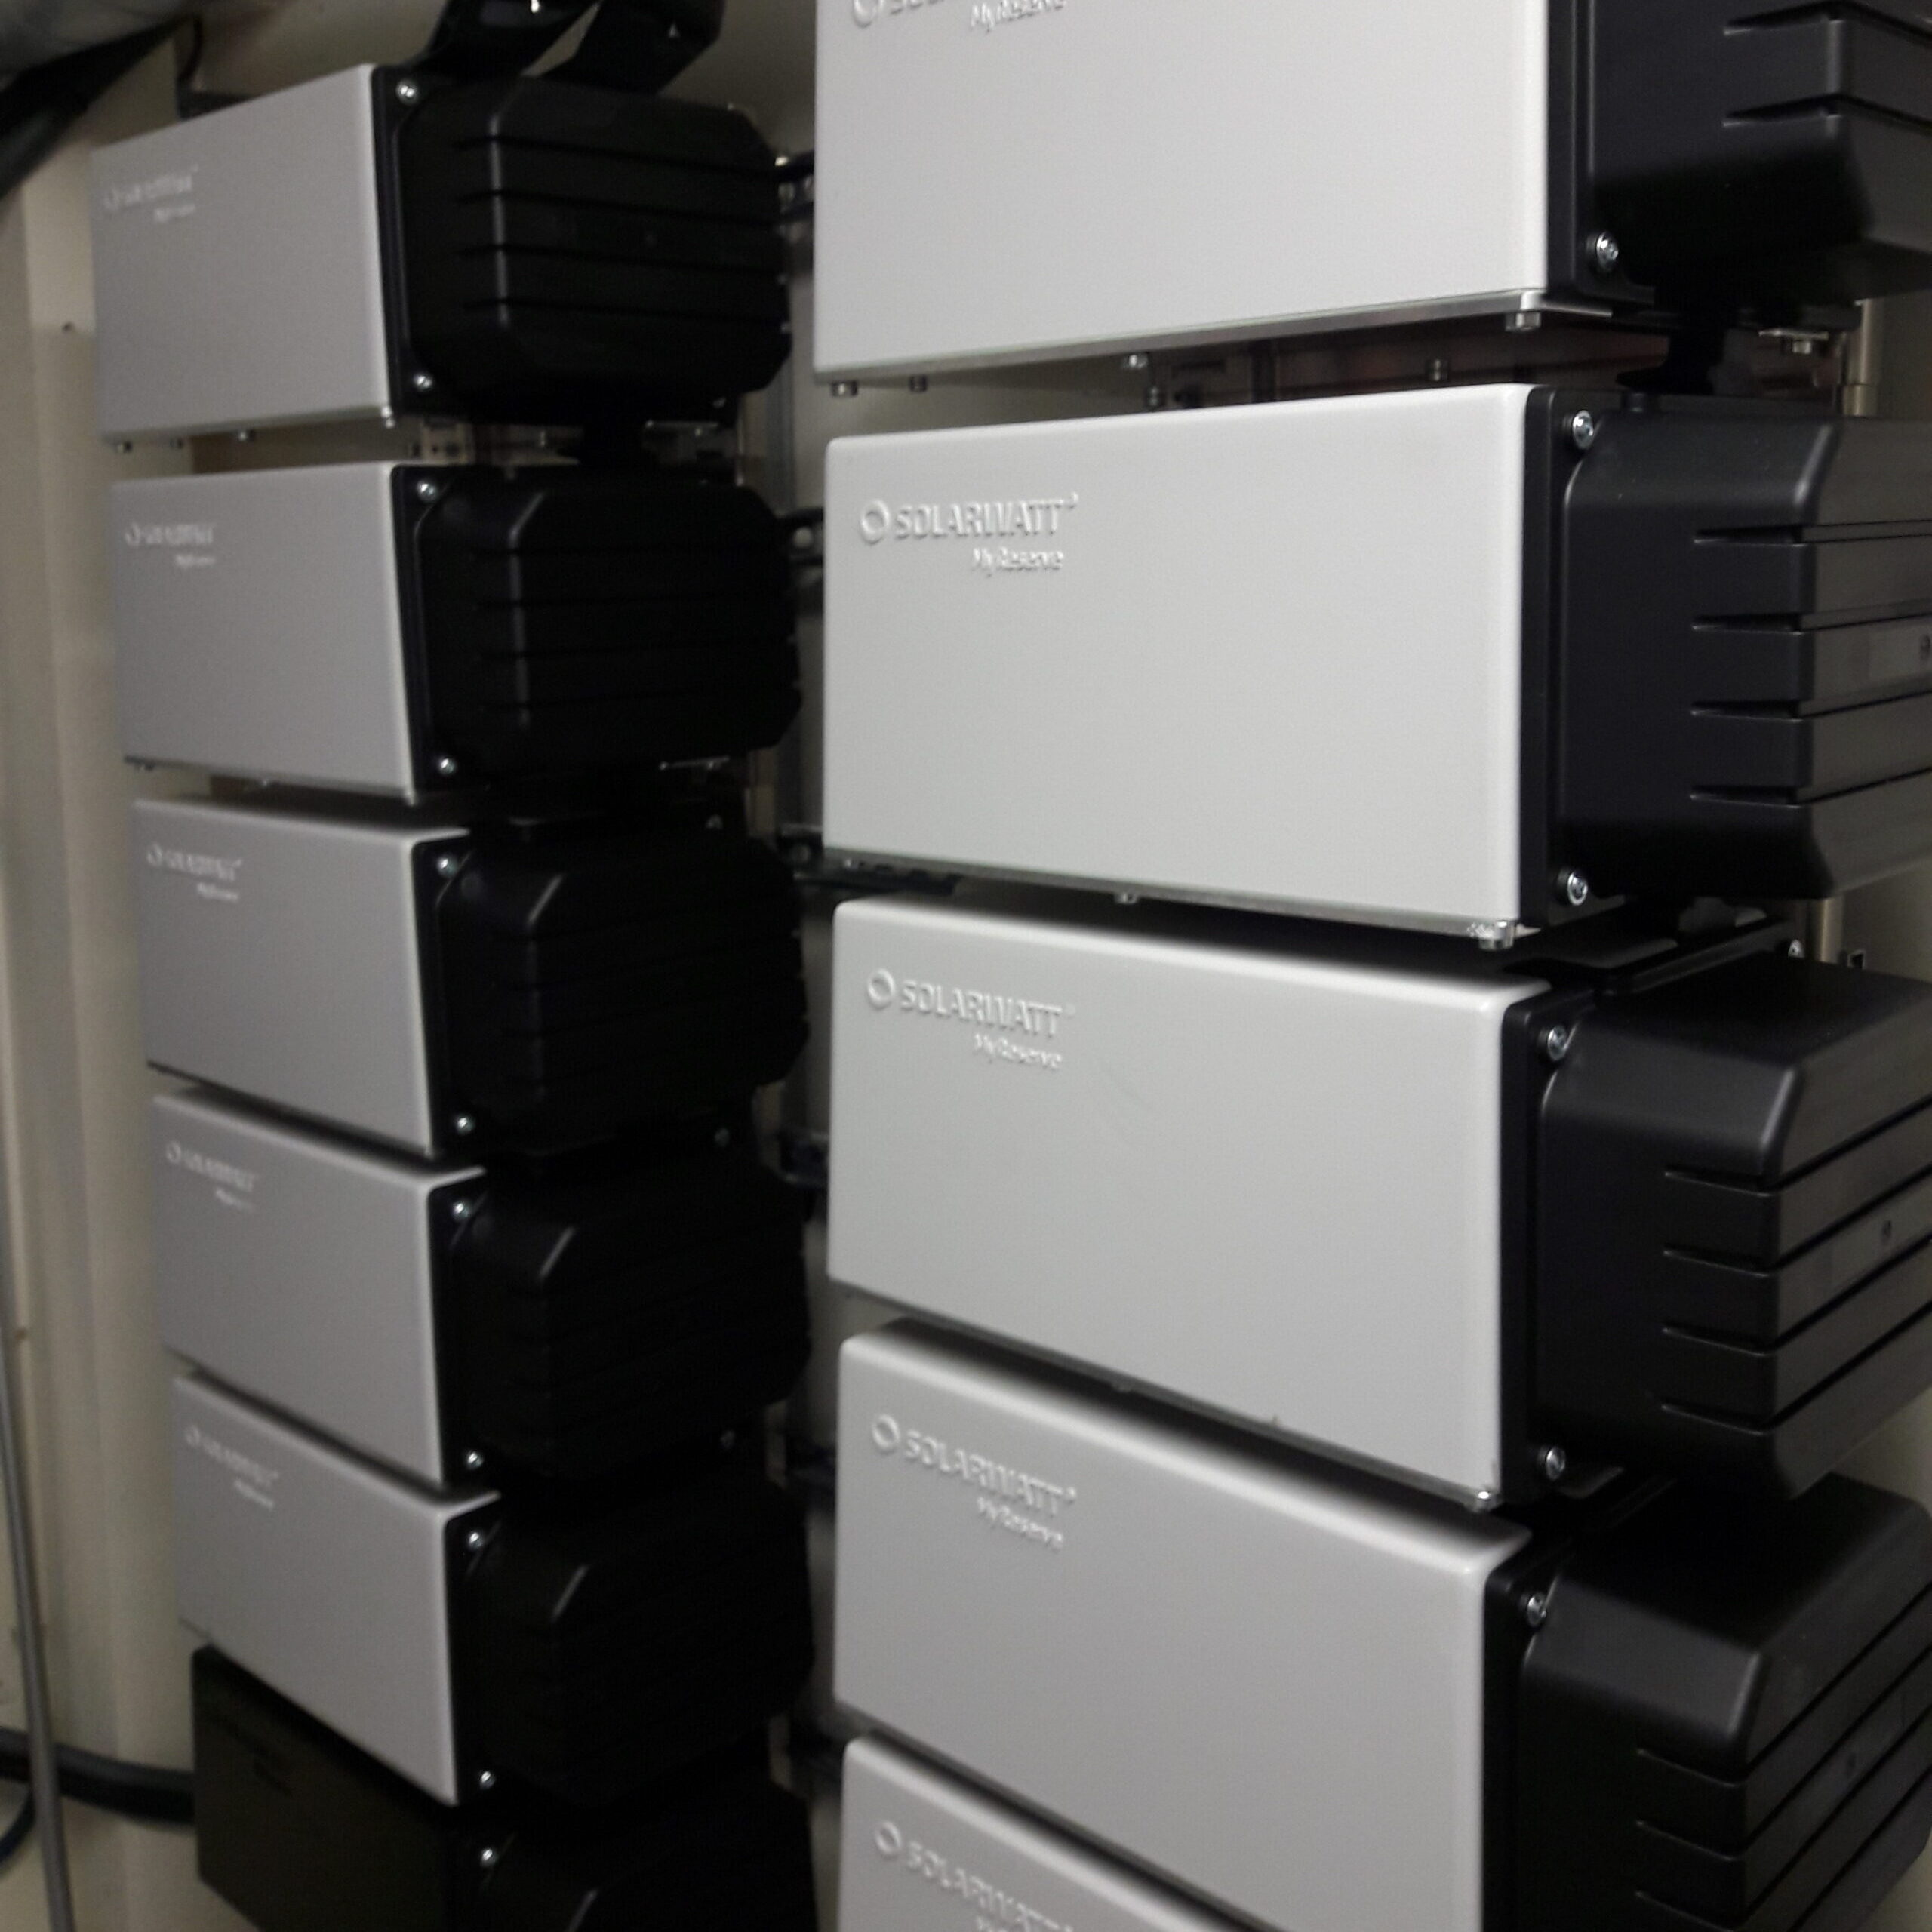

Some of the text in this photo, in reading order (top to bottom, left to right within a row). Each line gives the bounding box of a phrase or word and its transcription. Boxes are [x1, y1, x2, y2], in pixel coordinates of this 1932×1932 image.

[894, 498, 1064, 538] SOLARWATT
[900, 980, 1063, 1038] SOLARWATT
[904, 1429, 1064, 1517] SOLARWATT
